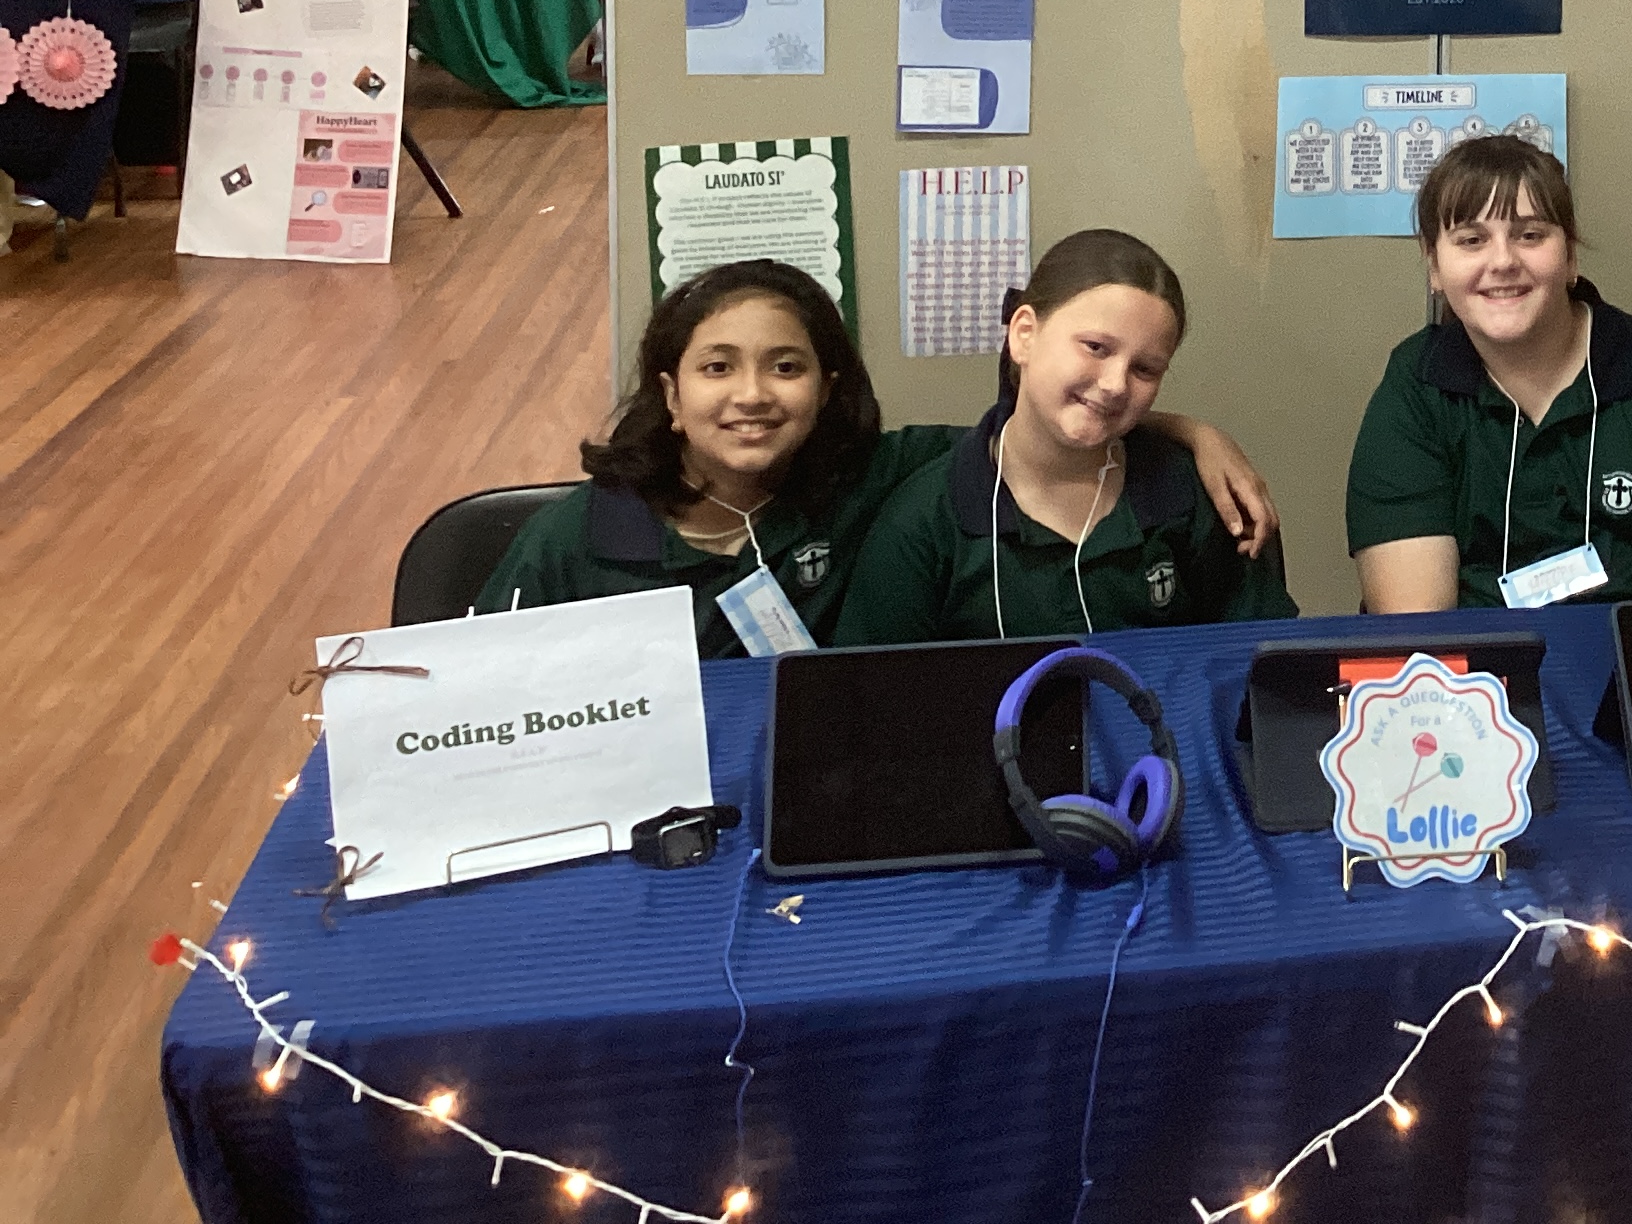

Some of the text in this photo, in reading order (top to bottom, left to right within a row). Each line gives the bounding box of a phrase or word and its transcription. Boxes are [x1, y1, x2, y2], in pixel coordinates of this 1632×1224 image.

[1396, 91, 1444, 103] TIMELINE
[1362, 123, 1368, 132] 2
[1416, 123, 1423, 132] 3
[705, 172, 765, 189] LAUDATO
[921, 170, 1024, 196] H.E.L.P
[396, 695, 651, 755] Coding Booklet
[1371, 717, 1388, 747] ASK
[1388, 706, 1399, 718] A
[1411, 715, 1431, 726] For
[1387, 805, 1478, 850] Lollie
